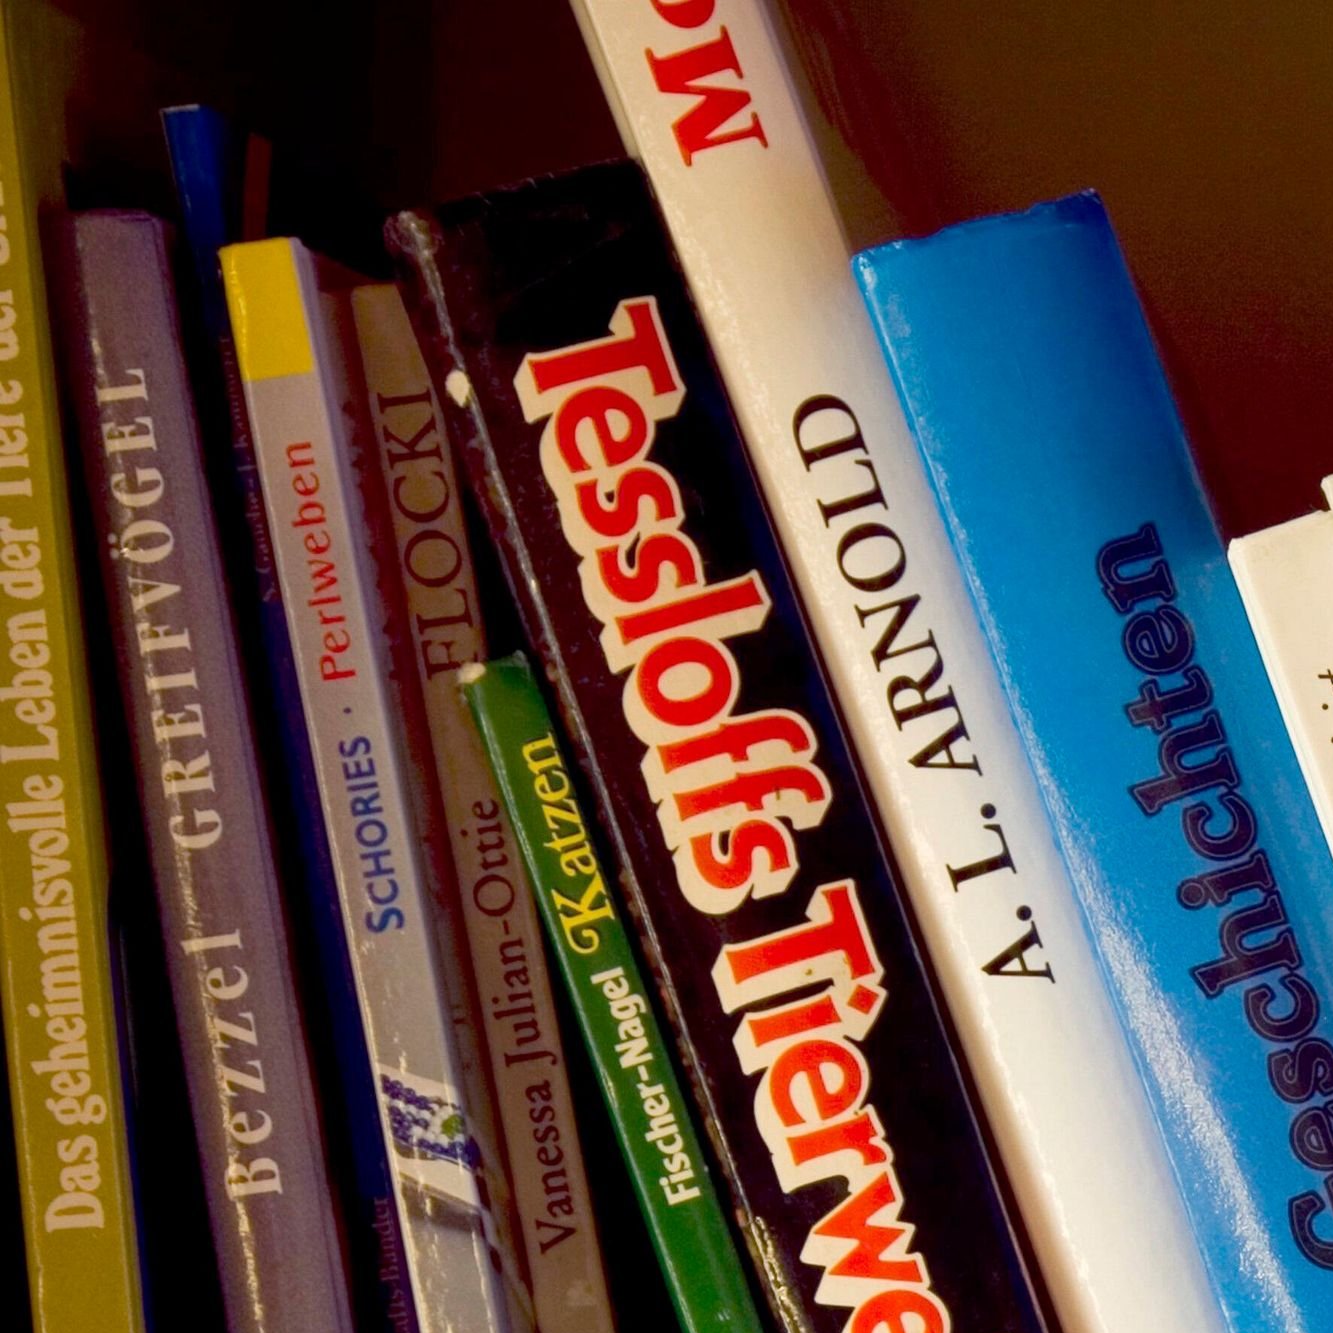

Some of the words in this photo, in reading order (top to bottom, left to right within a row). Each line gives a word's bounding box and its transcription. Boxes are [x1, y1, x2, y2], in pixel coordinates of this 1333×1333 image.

[0, 516, 46, 600] der
[95, 367, 224, 850] GREIFVÖGEL
[286, 440, 355, 684] Perlweben
[376, 393, 478, 681] FLOCKI
[514, 295, 832, 914] Tessloffs
[792, 394, 984, 778] ARNOLD
[2, 608, 60, 762] Leben
[3, 774, 106, 1126] geheimnisvolle
[337, 734, 406, 935] SCHORIES
[459, 798, 558, 1068] Julian-Ottie
[534, 731, 616, 956] Katzen
[947, 802, 1018, 893] L.
[981, 905, 1055, 983] A.
[47, 1133, 104, 1233] Das
[181, 928, 284, 1203] Bezzel
[535, 1080, 575, 1256] Vanessa
[590, 970, 700, 1206] Fischer-Nagel
